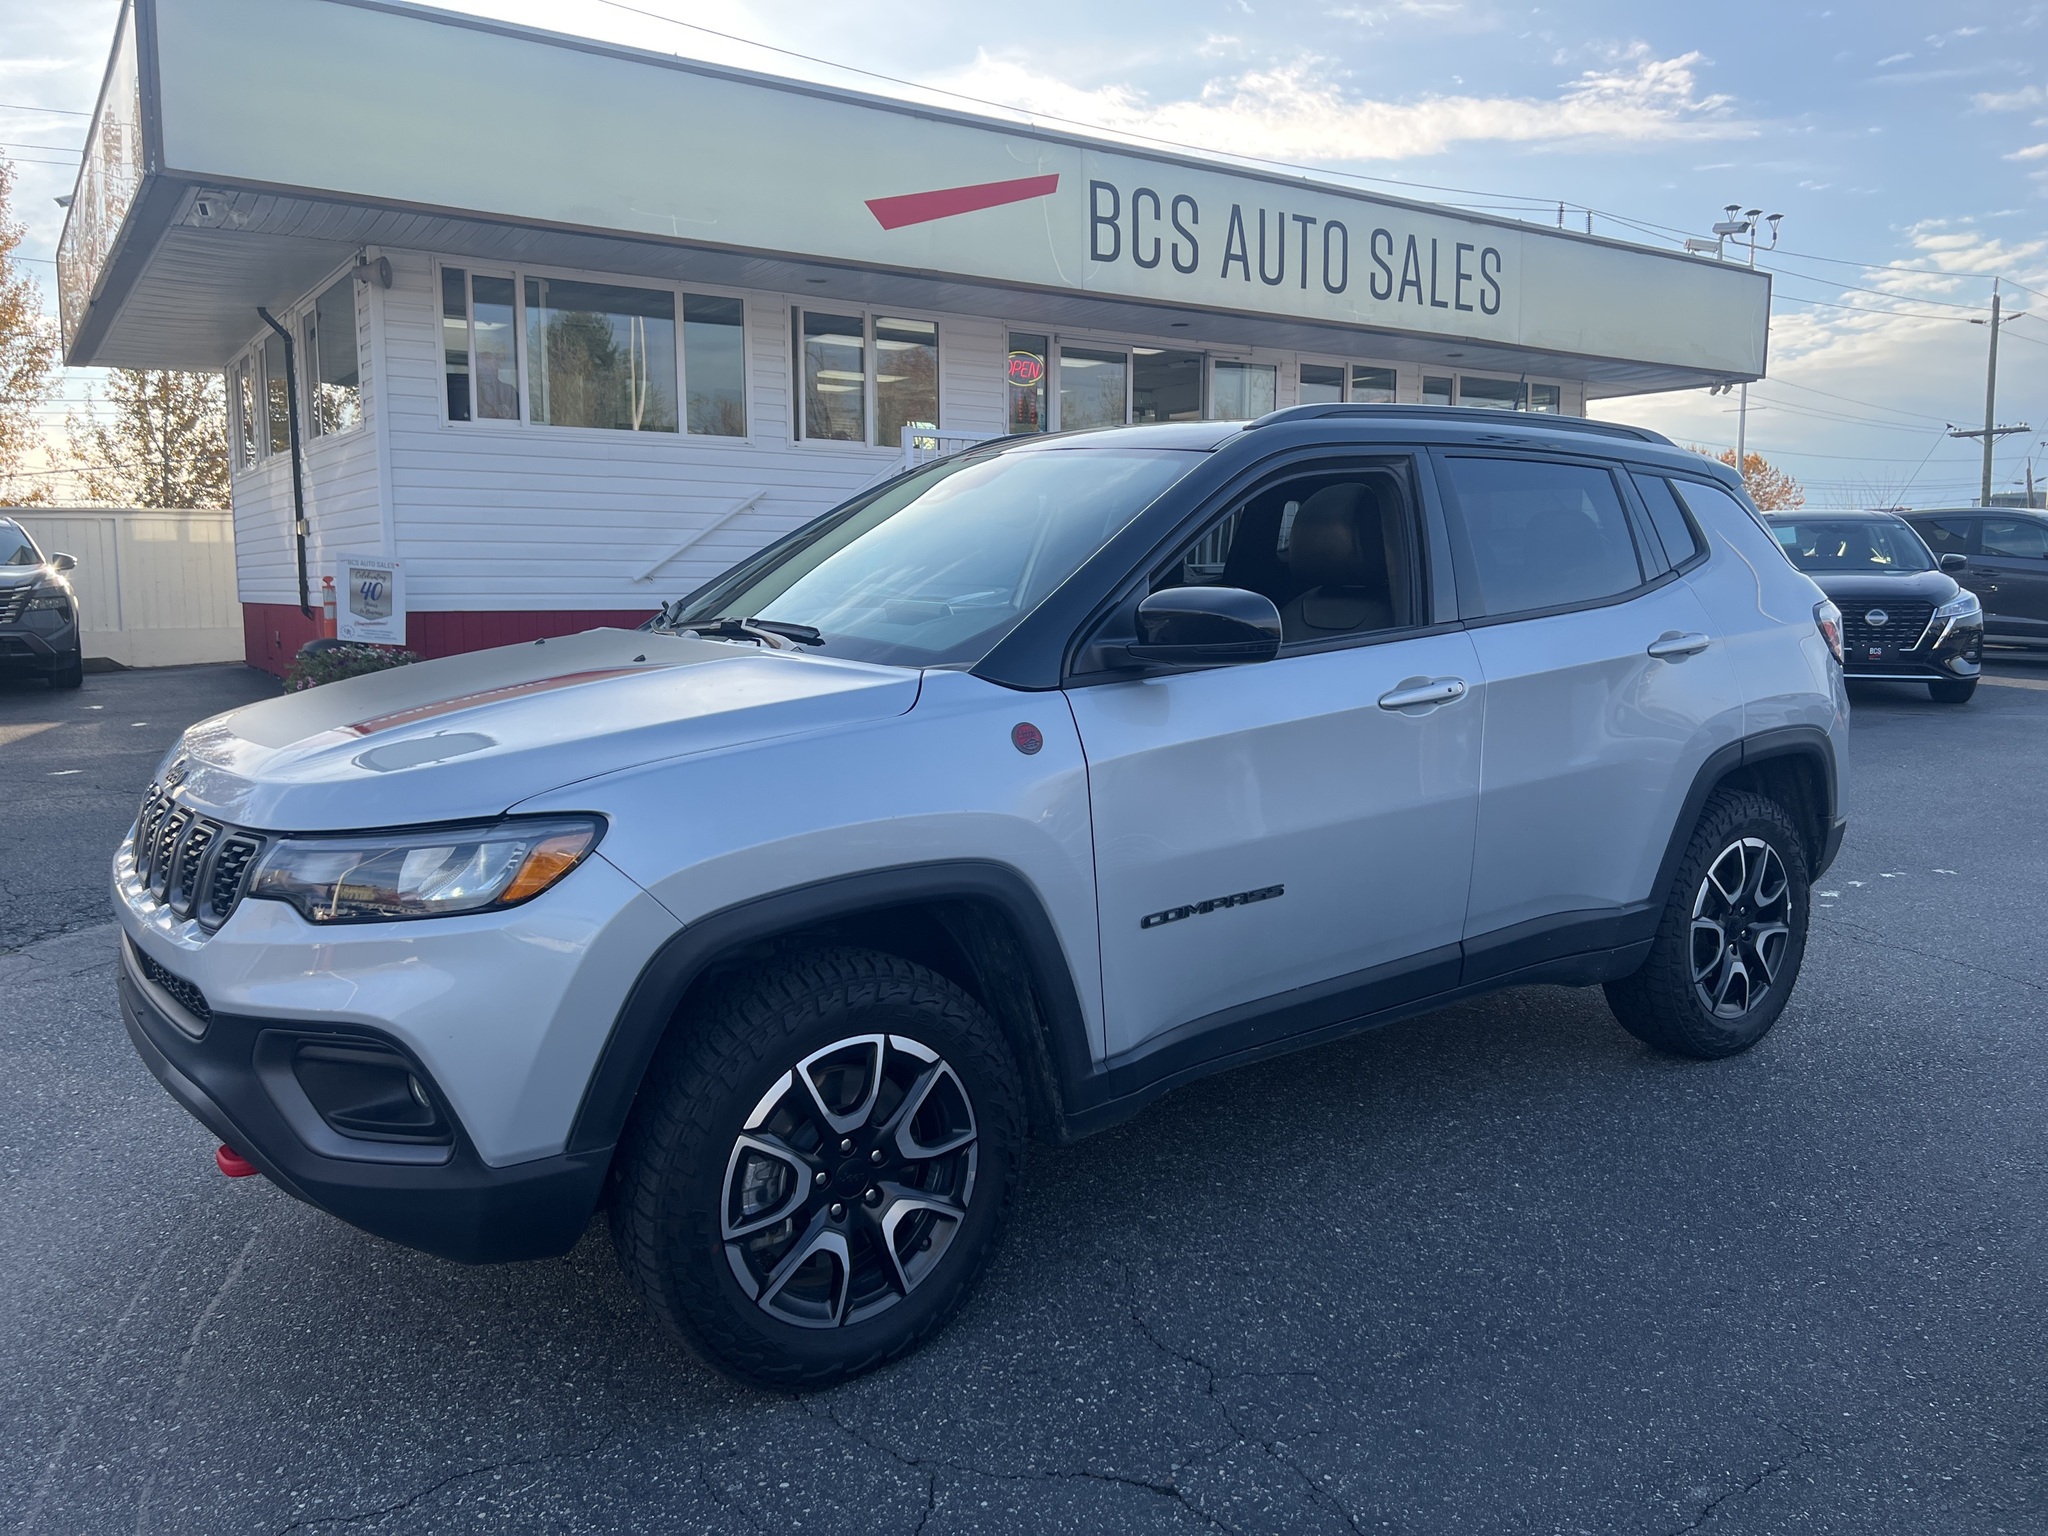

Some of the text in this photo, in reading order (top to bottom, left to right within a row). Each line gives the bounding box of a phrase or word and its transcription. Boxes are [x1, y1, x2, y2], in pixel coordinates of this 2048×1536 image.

[1089, 179, 1502, 316] BCS AUTO SALES
[348, 559, 396, 569] BCS AUTO SALES
[360, 581, 384, 601] 40
[1869, 647, 1882, 655] BCS
[1140, 883, 1285, 929] COMPASS
